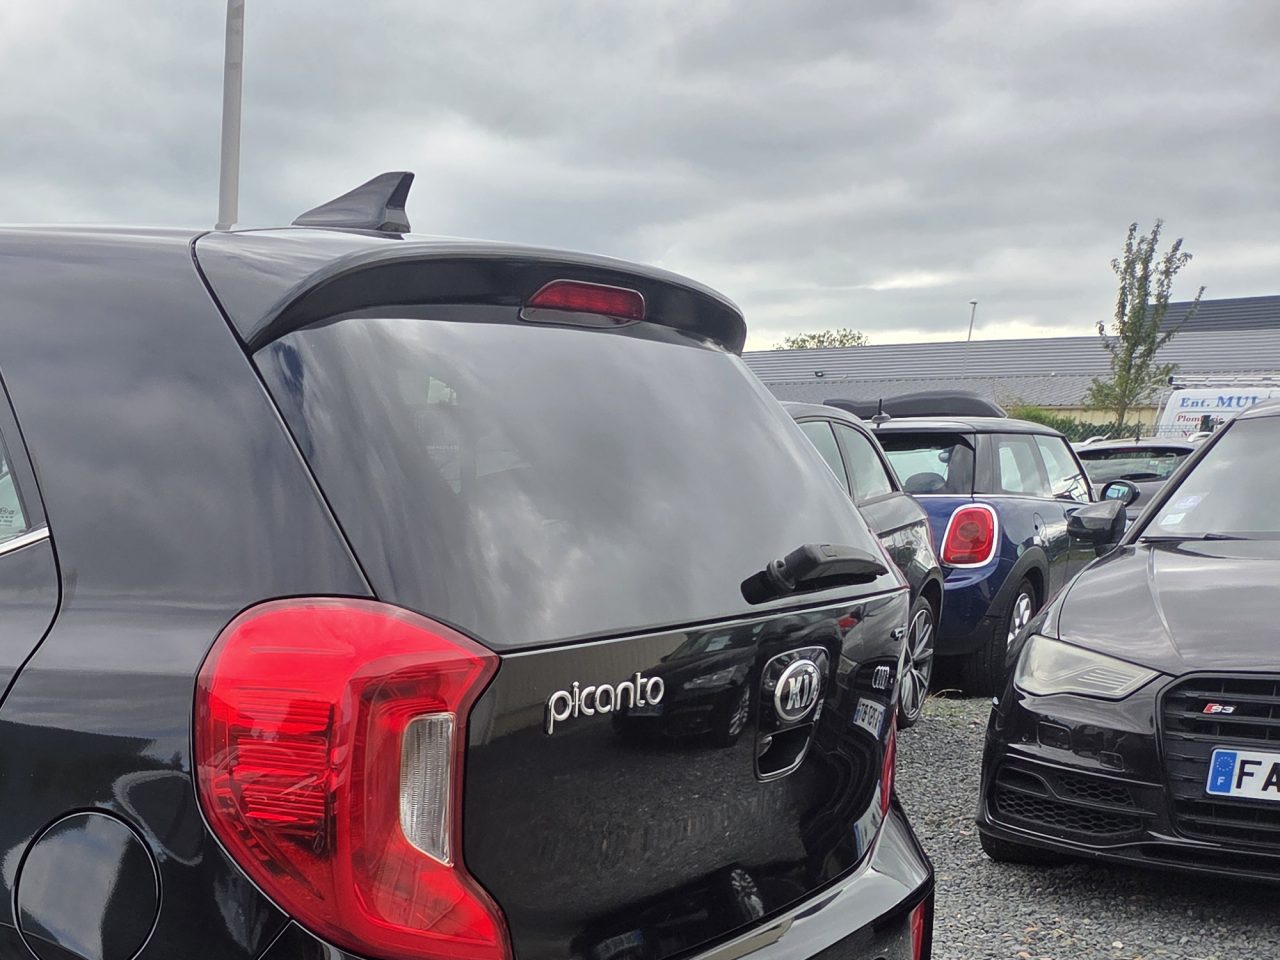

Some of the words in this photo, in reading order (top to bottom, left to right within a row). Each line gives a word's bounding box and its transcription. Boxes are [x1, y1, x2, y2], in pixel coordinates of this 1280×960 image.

[1180, 396, 1210, 408] Ent.
[1177, 415, 1223, 423] Plomrie
[785, 672, 818, 710] KIA
[545, 671, 665, 735] picanto
[1217, 776, 1225, 786] F
[1235, 759, 1280, 792] FA
